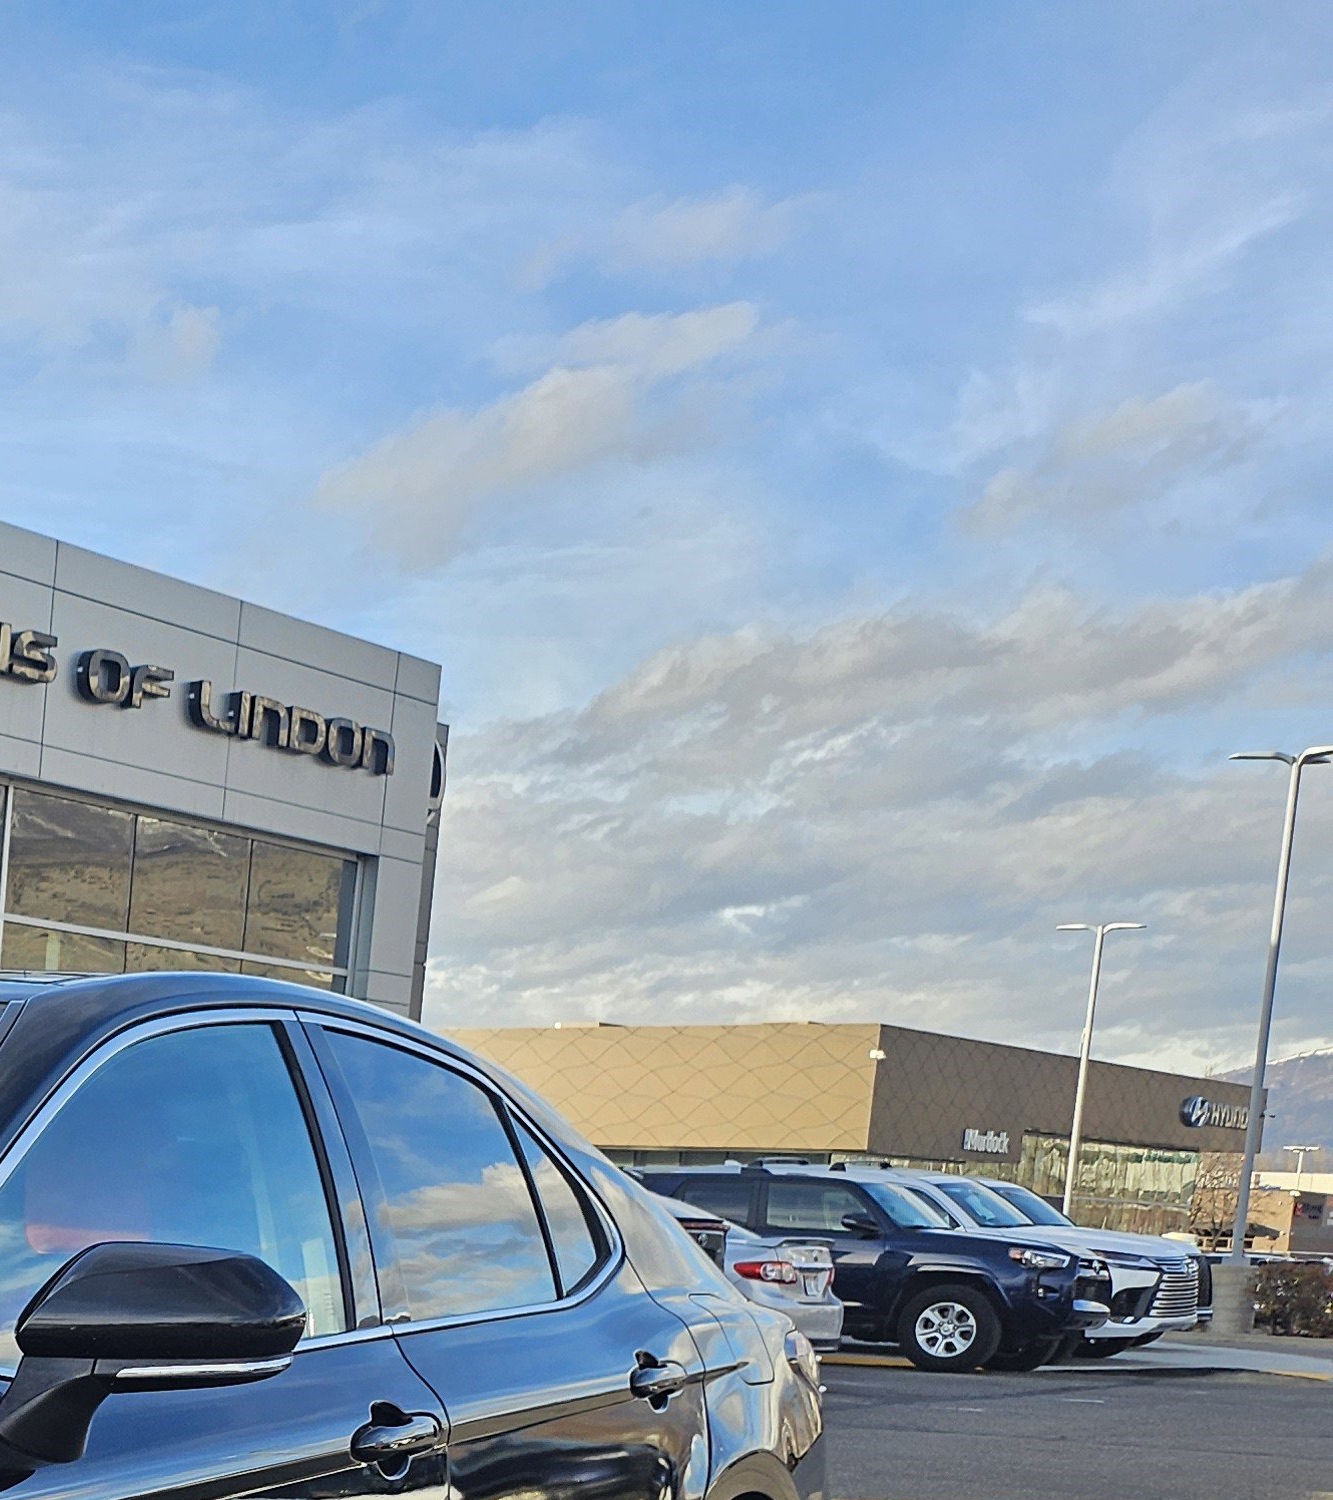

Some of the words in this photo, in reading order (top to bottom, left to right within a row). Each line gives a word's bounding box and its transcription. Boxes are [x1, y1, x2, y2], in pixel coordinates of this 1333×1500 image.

[77, 649, 175, 709] OF
[189, 680, 396, 776] LINDON
[1210, 1103, 1250, 1130] HYUND
[963, 1128, 1010, 1154] Murdock
